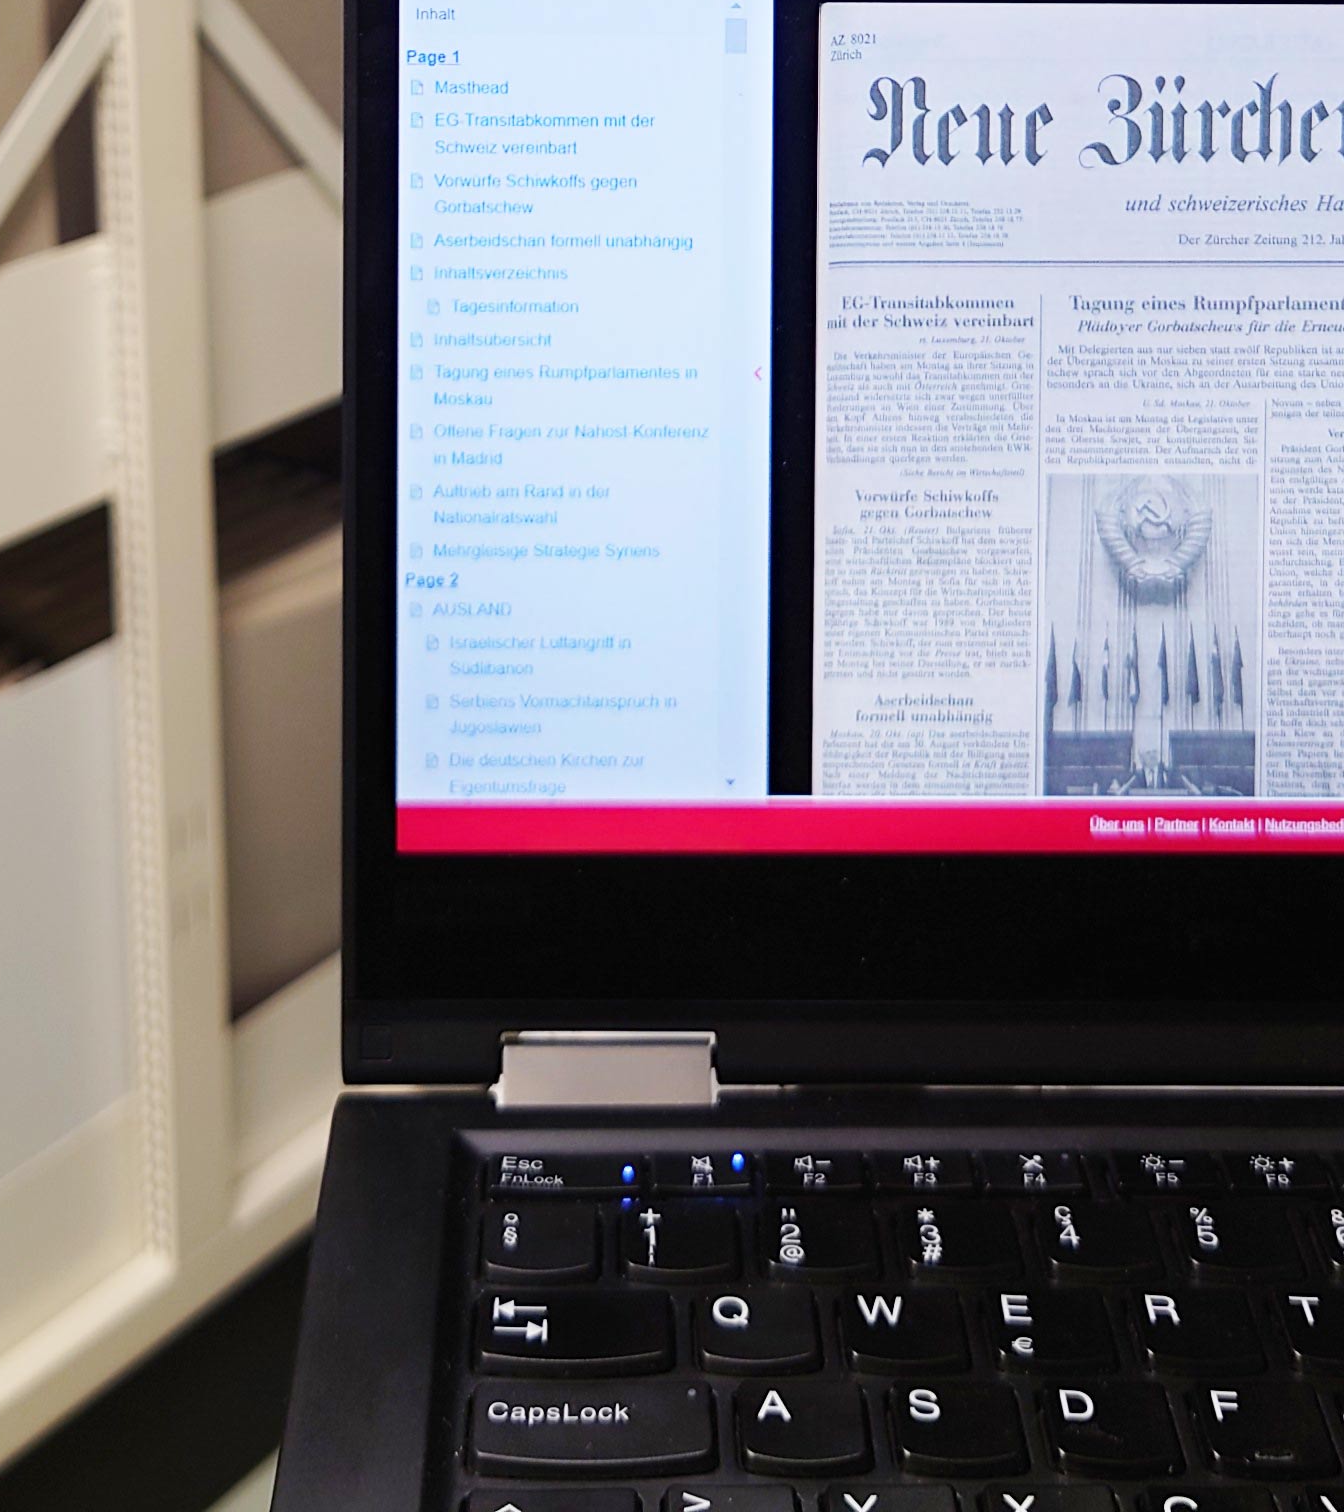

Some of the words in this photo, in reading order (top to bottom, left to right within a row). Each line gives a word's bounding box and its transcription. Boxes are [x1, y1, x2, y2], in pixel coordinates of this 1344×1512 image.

[417, 8, 455, 20] Inhalt
[831, 35, 845, 46] AZ
[851, 33, 875, 44] 8021
[407, 50, 446, 64] Page
[453, 51, 458, 63] 1
[831, 49, 862, 61] Zürich
[435, 81, 508, 94] Masthead
[604, 115, 627, 128] mit
[631, 115, 654, 128] der
[863, 77, 1053, 168] Neue
[436, 140, 497, 153] Schweiz
[502, 141, 576, 154] vereinbart
[1126, 194, 1161, 211] und
[1168, 194, 1307, 211] schweizerisches
[1179, 234, 1200, 245] Der
[1205, 234, 1249, 245] Zürcher
[1254, 234, 1297, 247] Zeitung
[1303, 234, 1325, 245] 212.
[843, 296, 1014, 309] EG-Transitabkommen
[1069, 296, 1134, 314] Tagung
[1142, 296, 1185, 310] eines
[828, 316, 846, 328] mit
[853, 315, 878, 327] der
[884, 314, 947, 327] Schweiz
[955, 314, 1033, 327] vereinbart
[434, 393, 493, 407] Moskau
[924, 490, 998, 502] Schiwkoffs
[860, 510, 898, 520] gegen
[905, 506, 991, 518] Gorbatschew
[405, 573, 444, 588] Page
[449, 572, 459, 587] 2
[1090, 815, 1119, 832] Über
[1122, 818, 1145, 832] uns
[1155, 816, 1199, 832] Partner
[1208, 816, 1255, 832] Kontakt
[498, 1155, 547, 1170] Esc
[498, 1172, 566, 1186] FnLock
[713, 1296, 749, 1327] Q
[857, 1295, 901, 1325] W
[1001, 1294, 1032, 1324] E
[1145, 1294, 1180, 1324] R
[1289, 1296, 1319, 1325] T
[758, 1391, 791, 1421] A
[909, 1389, 940, 1421] S
[1059, 1389, 1094, 1420] D
[1210, 1390, 1238, 1421] F
[488, 1402, 628, 1426] CapsLock
